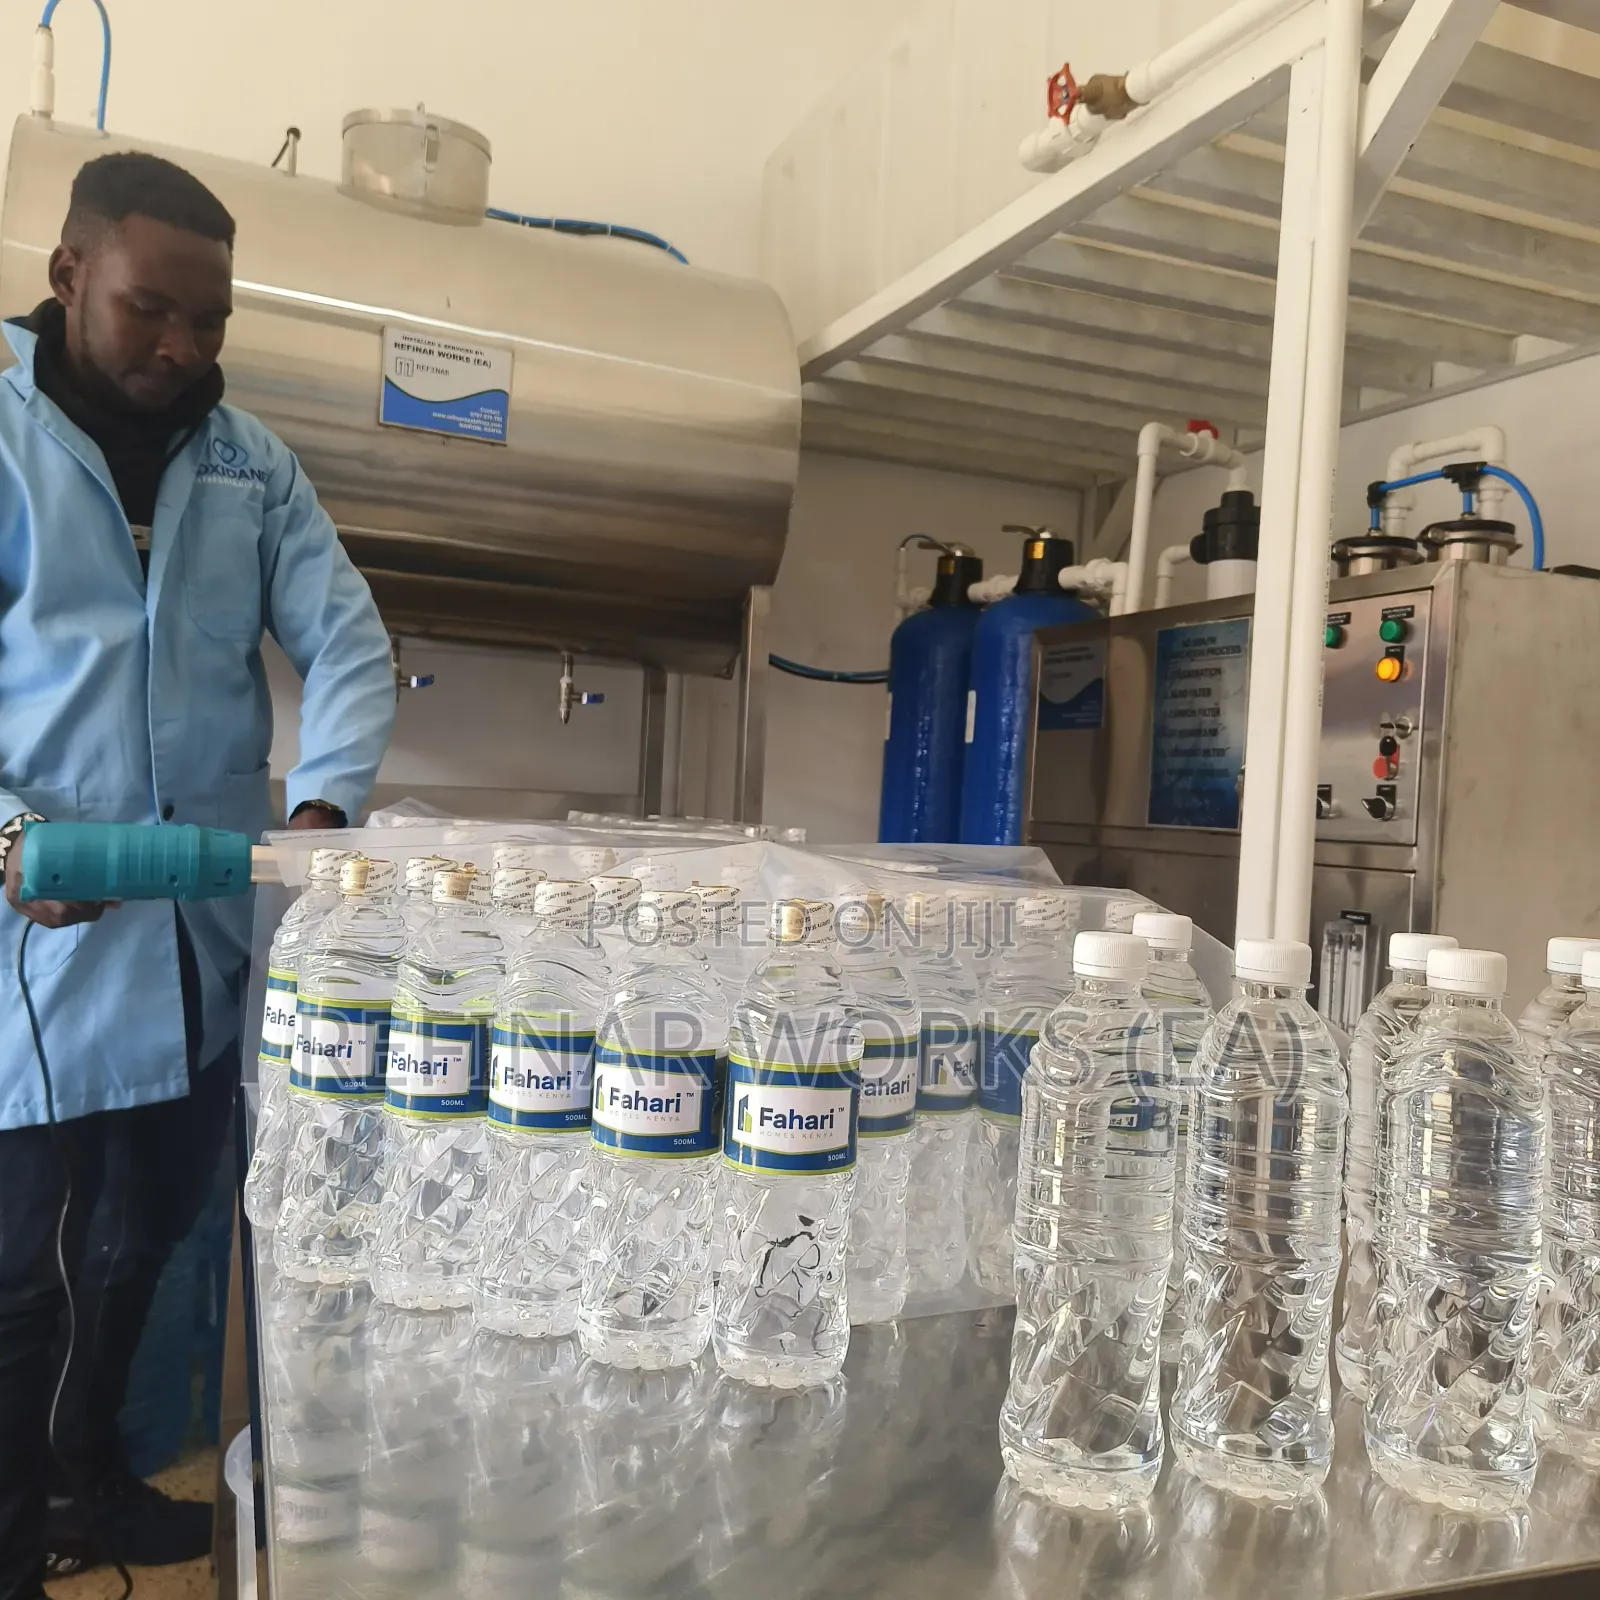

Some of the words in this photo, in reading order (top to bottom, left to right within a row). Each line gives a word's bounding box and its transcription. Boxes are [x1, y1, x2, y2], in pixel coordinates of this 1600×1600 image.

[394, 342, 435, 356] REFINAR
[437, 350, 471, 364] WORKS
[473, 358, 492, 369] (EA)
[416, 364, 450, 376] REFINAR
[265, 1006, 296, 1027] Faha
[296, 1033, 353, 1059] Fahari
[391, 1050, 448, 1076] Fahari
[953, 1058, 976, 1078] Fah
[504, 1066, 572, 1091] Fahari
[441, 1099, 465, 1107] 500ML
[538, 1092, 571, 1100] KENYA
[609, 1086, 682, 1114] Fahari
[564, 1114, 588, 1122] 500ML
[646, 1114, 681, 1122] KENYA
[759, 1106, 835, 1131] Fahari
[672, 1138, 697, 1146] 500ML
[759, 1130, 796, 1139] HOMES
[827, 1152, 847, 1162] 500ML
